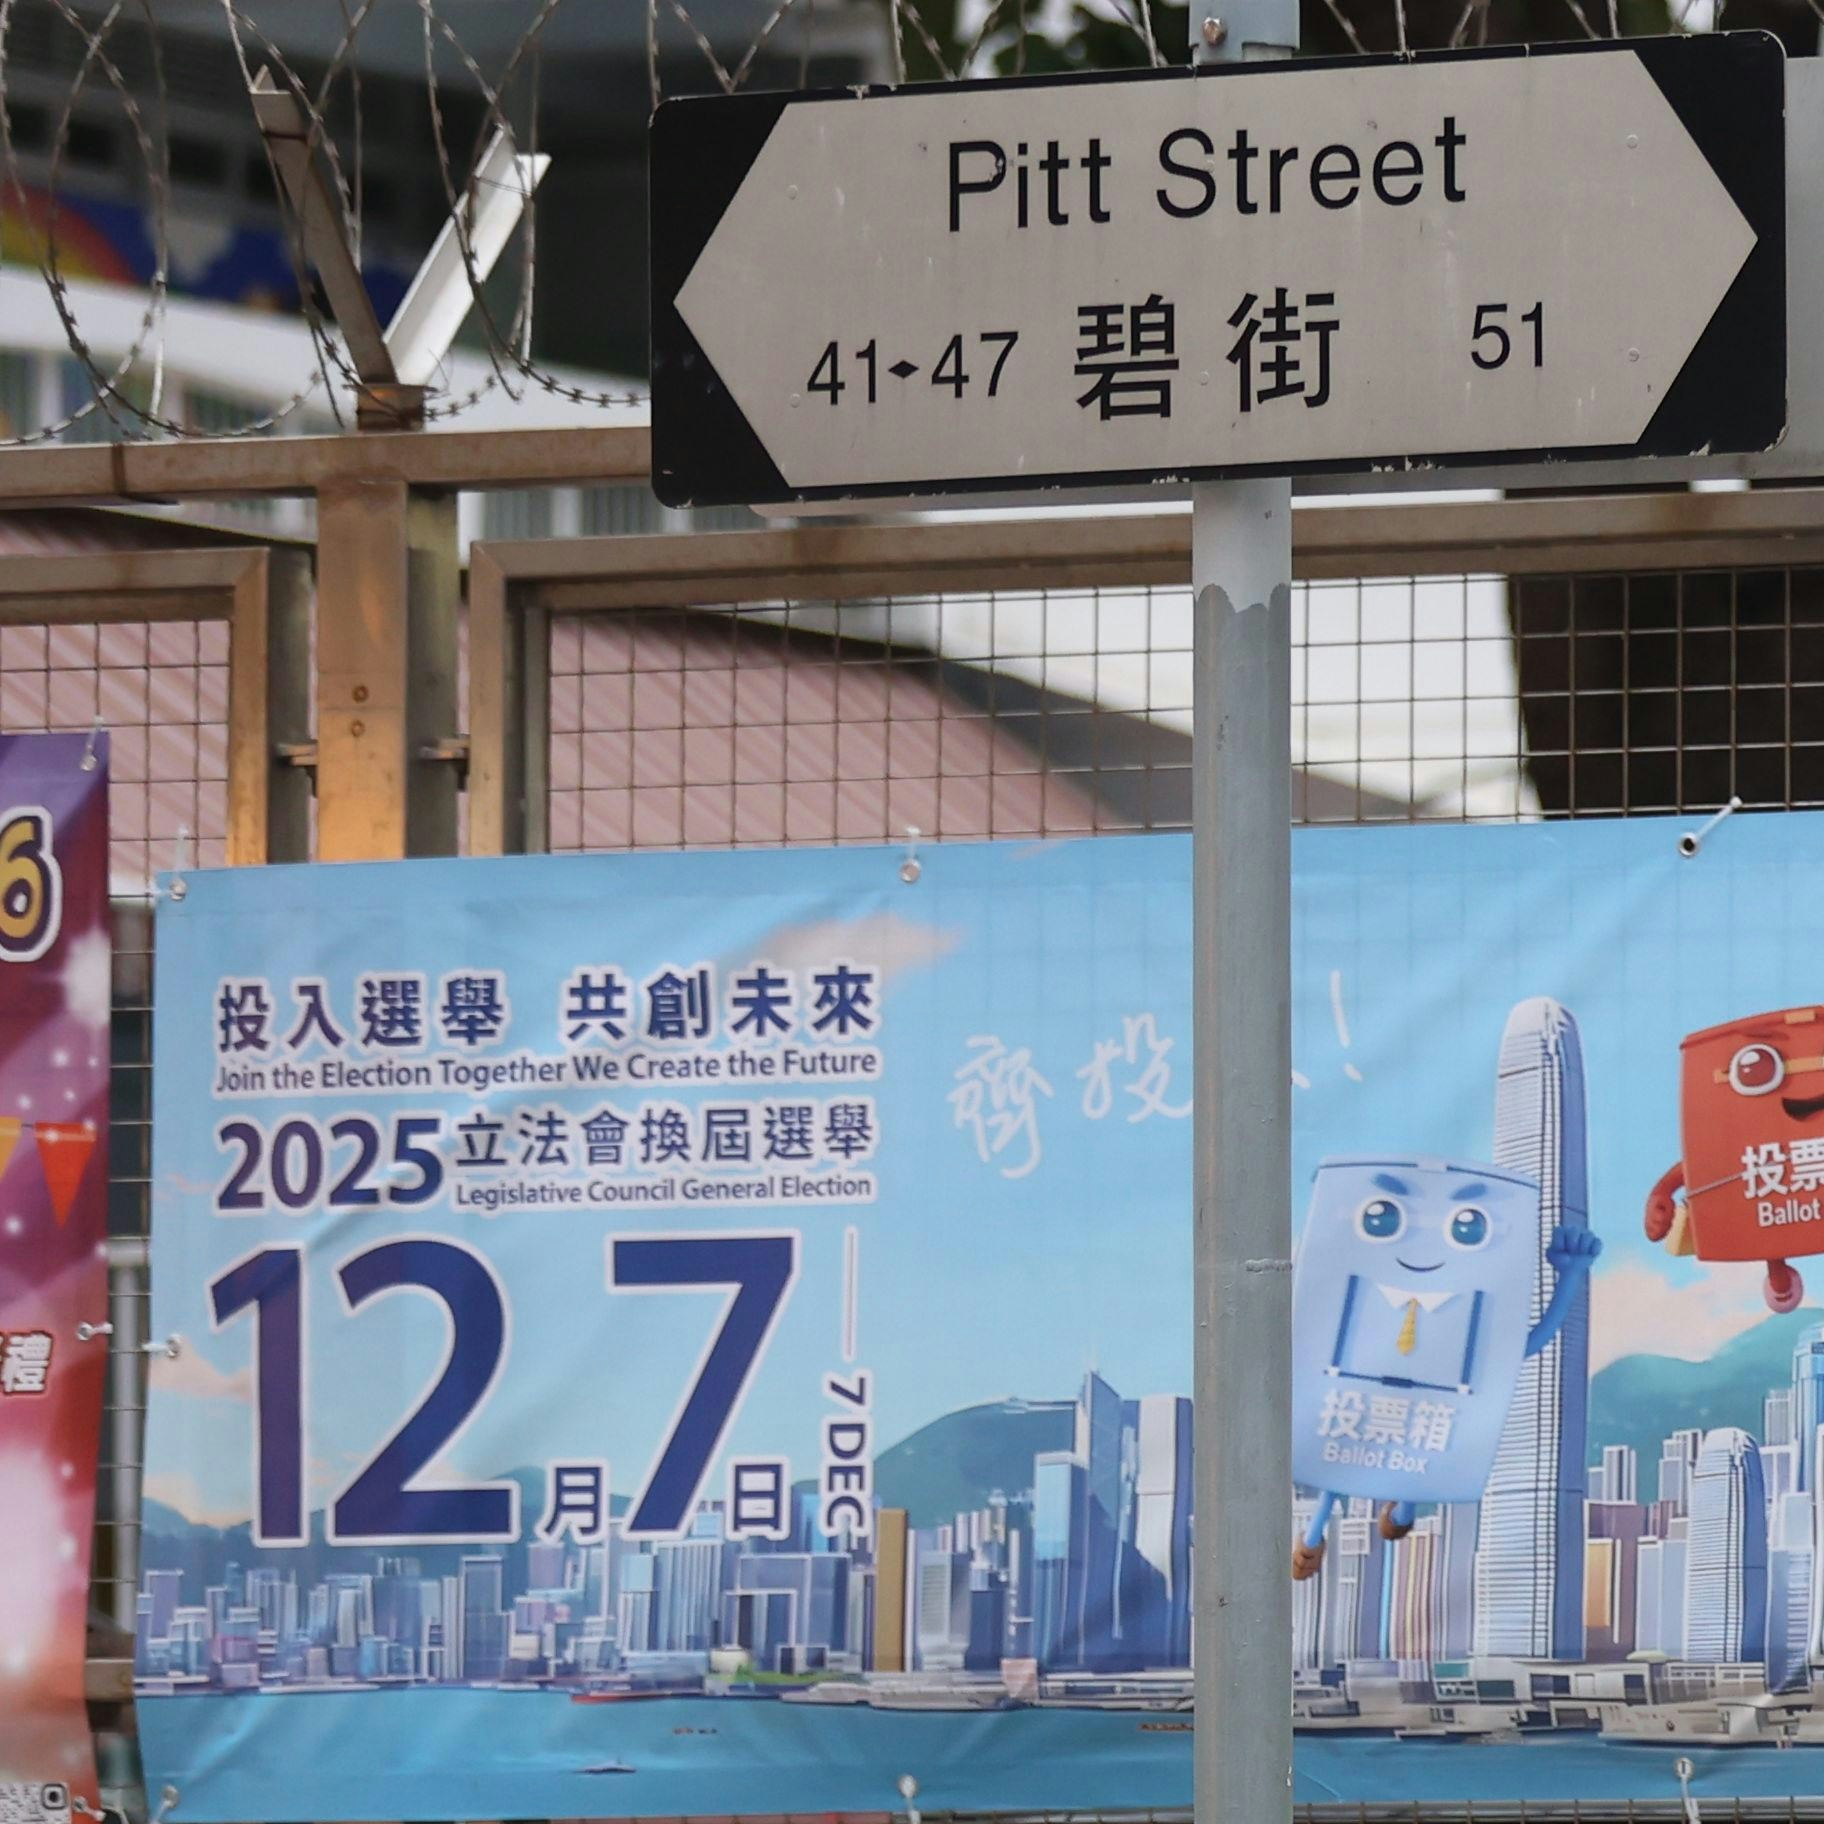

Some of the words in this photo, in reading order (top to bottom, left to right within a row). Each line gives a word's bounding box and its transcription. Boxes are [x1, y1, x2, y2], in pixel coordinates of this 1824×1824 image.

[947, 134, 1113, 233] Pitt
[1156, 116, 1468, 221] Street
[1073, 286, 1342, 423] 碧街
[1468, 300, 1548, 372] 51
[218, 977, 504, 1053] 投入選舉
[566, 964, 876, 1042] 共創未來
[215, 1066, 269, 1095] Join
[273, 1064, 315, 1087] the
[322, 1061, 432, 1088] Election
[440, 1056, 567, 1089] Together
[572, 1054, 623, 1081] We
[627, 1053, 720, 1081] Create
[725, 1050, 776, 1077] the
[782, 1048, 877, 1076] Future
[216, 1117, 445, 1210] 2025
[456, 1104, 874, 1170] 立法會換屆選舉
[455, 1181, 584, 1208] Legislative
[587, 1179, 675, 1204] Council
[680, 1177, 776, 1202] General
[780, 1175, 872, 1199] Election
[1757, 1198, 1821, 1227] Ballot
[210, 1237, 793, 1540] 12月7日
[1317, 1387, 1457, 1453] 投票箱
[829, 1424, 867, 1539] DEC
[1323, 1441, 1386, 1470] Ballot
[1388, 1450, 1429, 1475] Box
